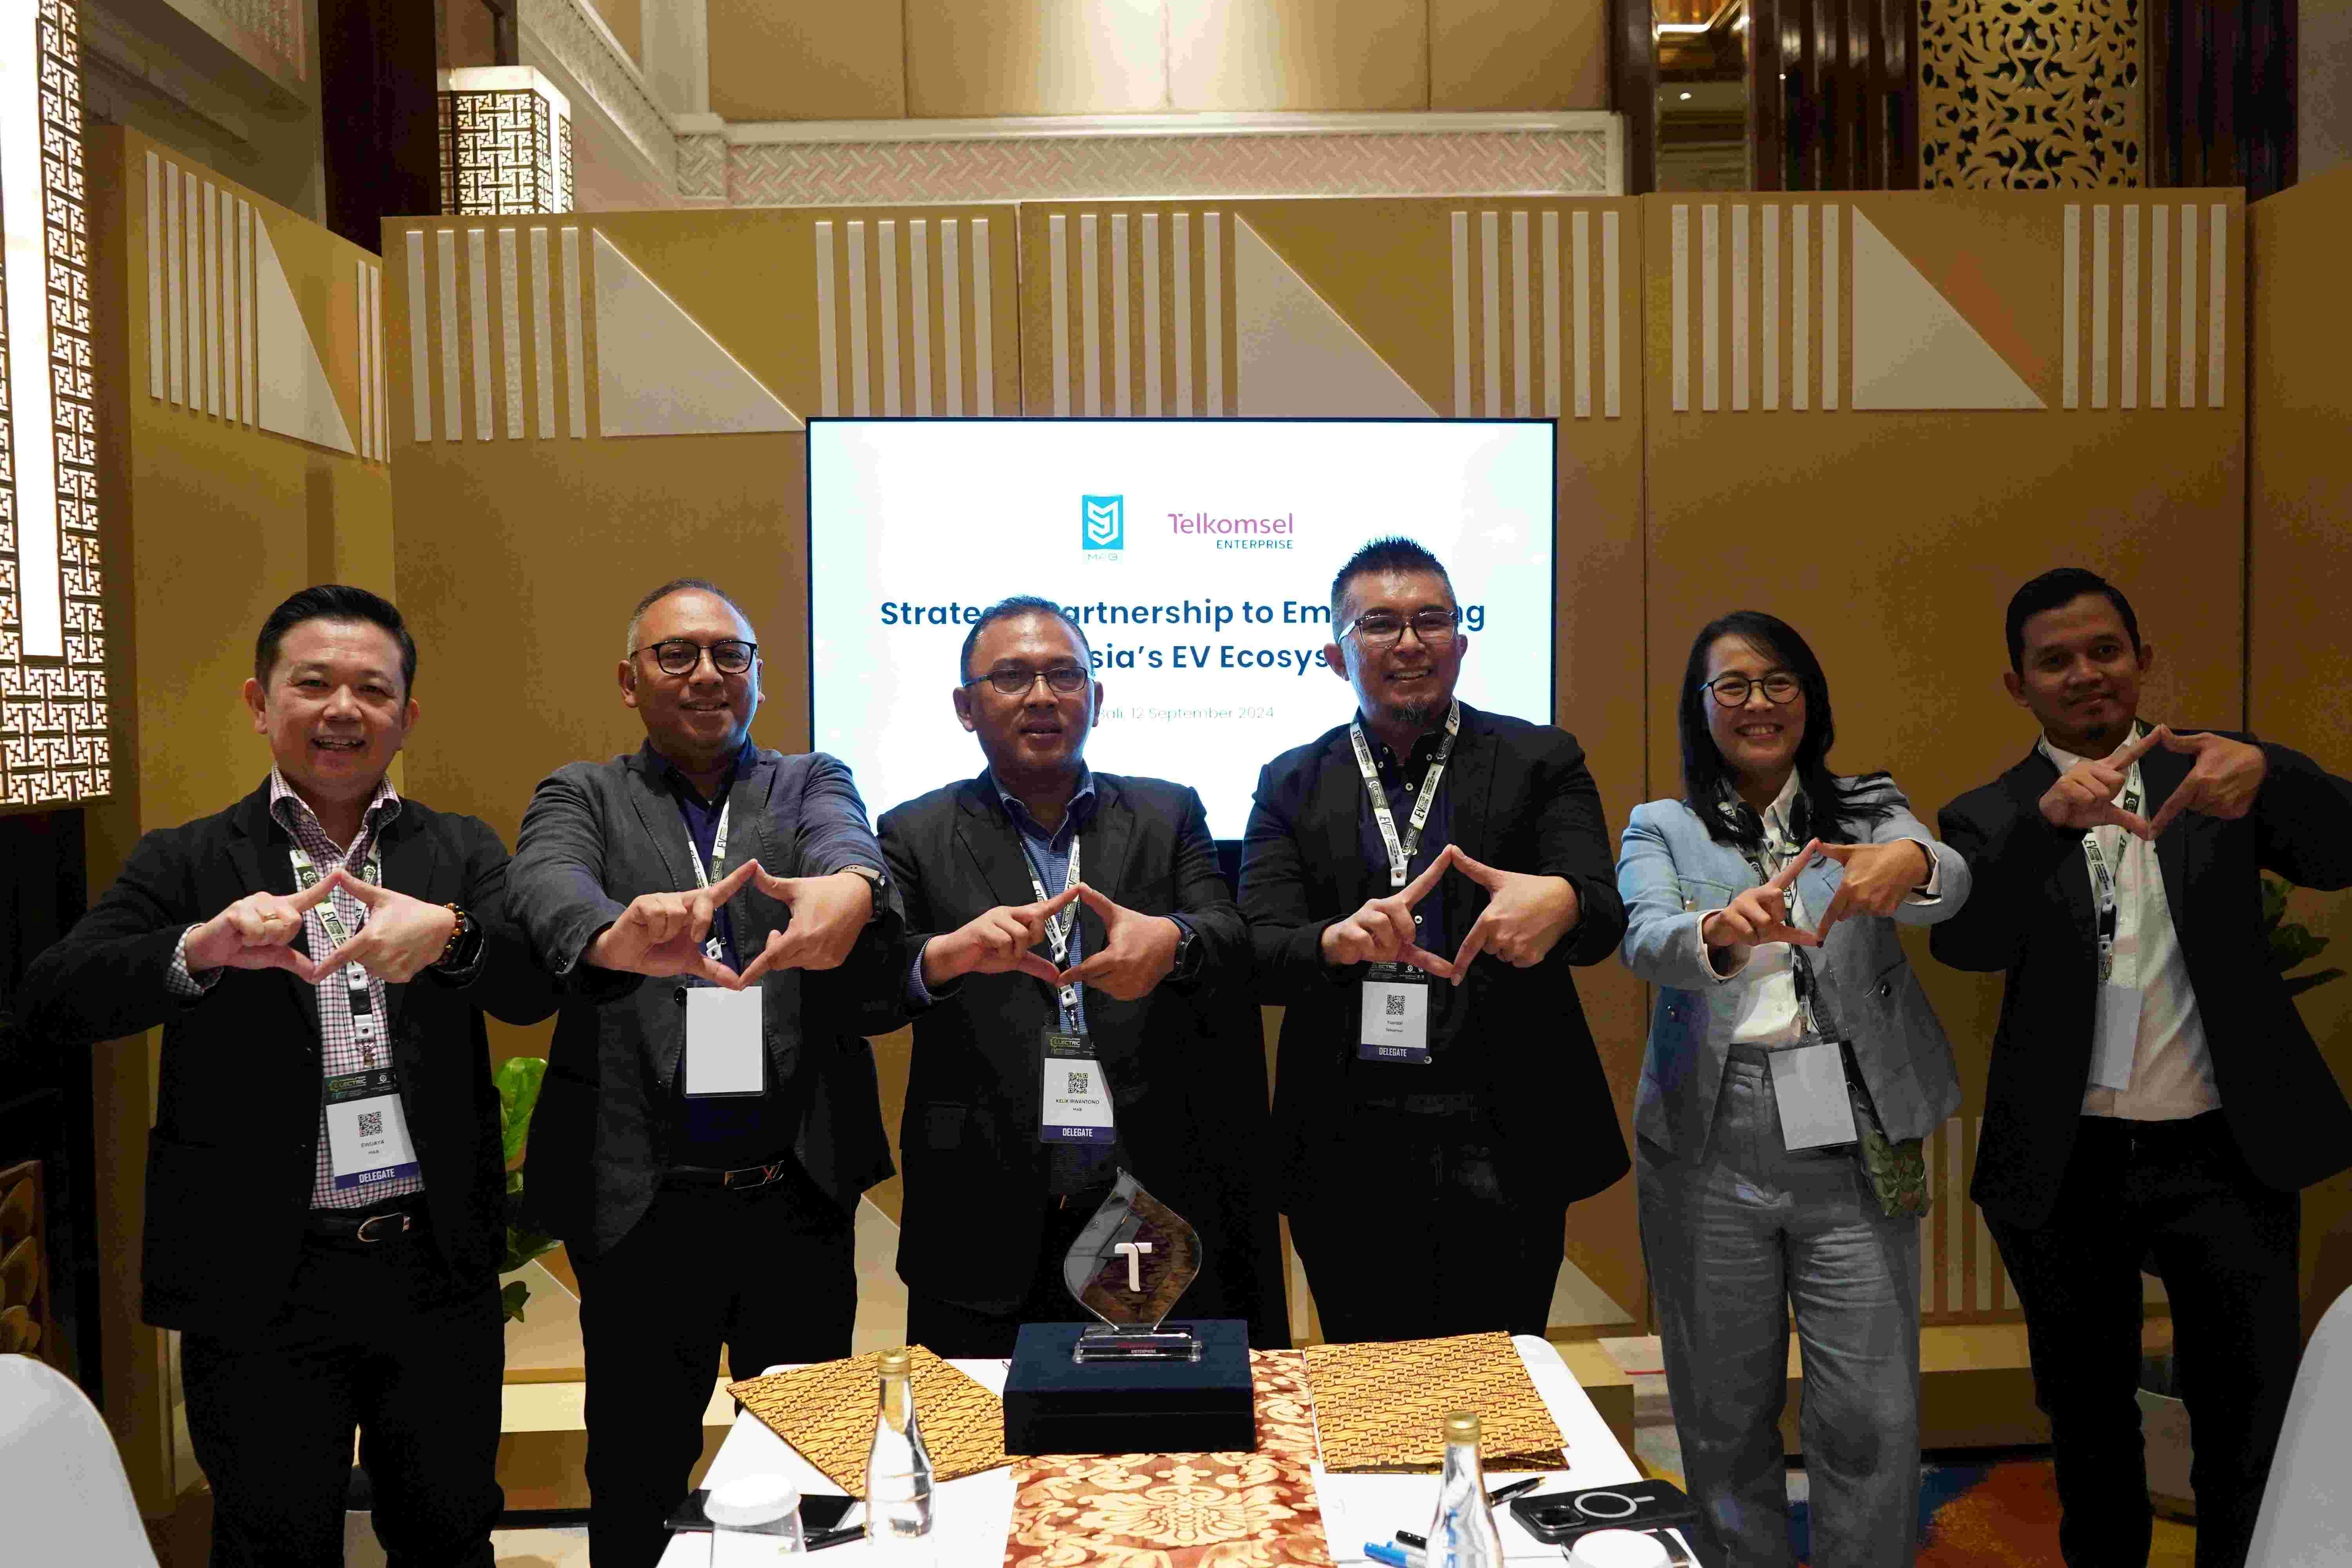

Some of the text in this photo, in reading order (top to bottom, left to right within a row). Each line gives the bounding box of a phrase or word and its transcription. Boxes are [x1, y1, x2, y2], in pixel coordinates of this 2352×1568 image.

[1167, 513, 1293, 534] Telkomsel
[1216, 540, 1294, 549] ENTERPRISE
[1065, 598, 1234, 631] artnership
[1243, 601, 1274, 624] to
[1173, 646, 1211, 668] EV
[1221, 646, 1325, 676] Ecosys
[1131, 708, 1144, 718] 12
[1150, 707, 1232, 720] September
[1239, 707, 1275, 718] 2024
[1379, 1047, 1408, 1057] DELEGATE
[1062, 1128, 1093, 1137] DELEGATE
[358, 1168, 396, 1183] DELEGATE
